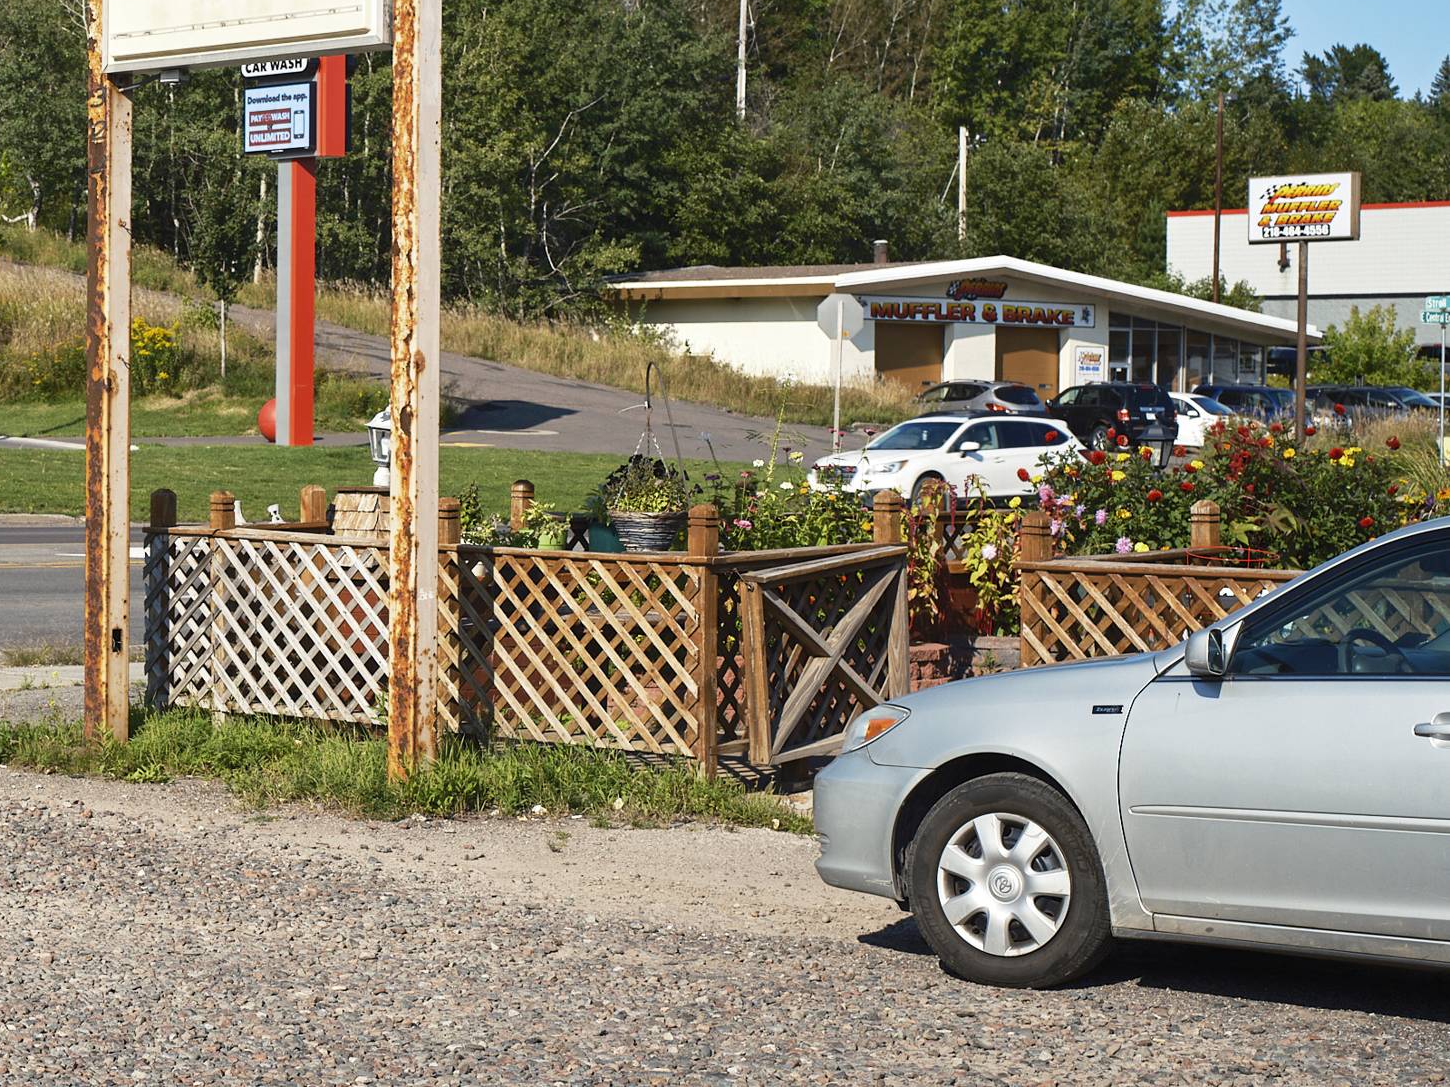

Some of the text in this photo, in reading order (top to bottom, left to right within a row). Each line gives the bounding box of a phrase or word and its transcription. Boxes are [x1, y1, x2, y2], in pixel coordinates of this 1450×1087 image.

[245, 58, 303, 74] CAR WASH
[247, 93, 281, 105] Download
[281, 92, 292, 102] the
[250, 131, 291, 143] UNLIMITED
[1260, 200, 1343, 214] MUFFLER
[1274, 212, 1337, 225] BRAKE
[870, 302, 1076, 325] MUFFLER & BRAKE
